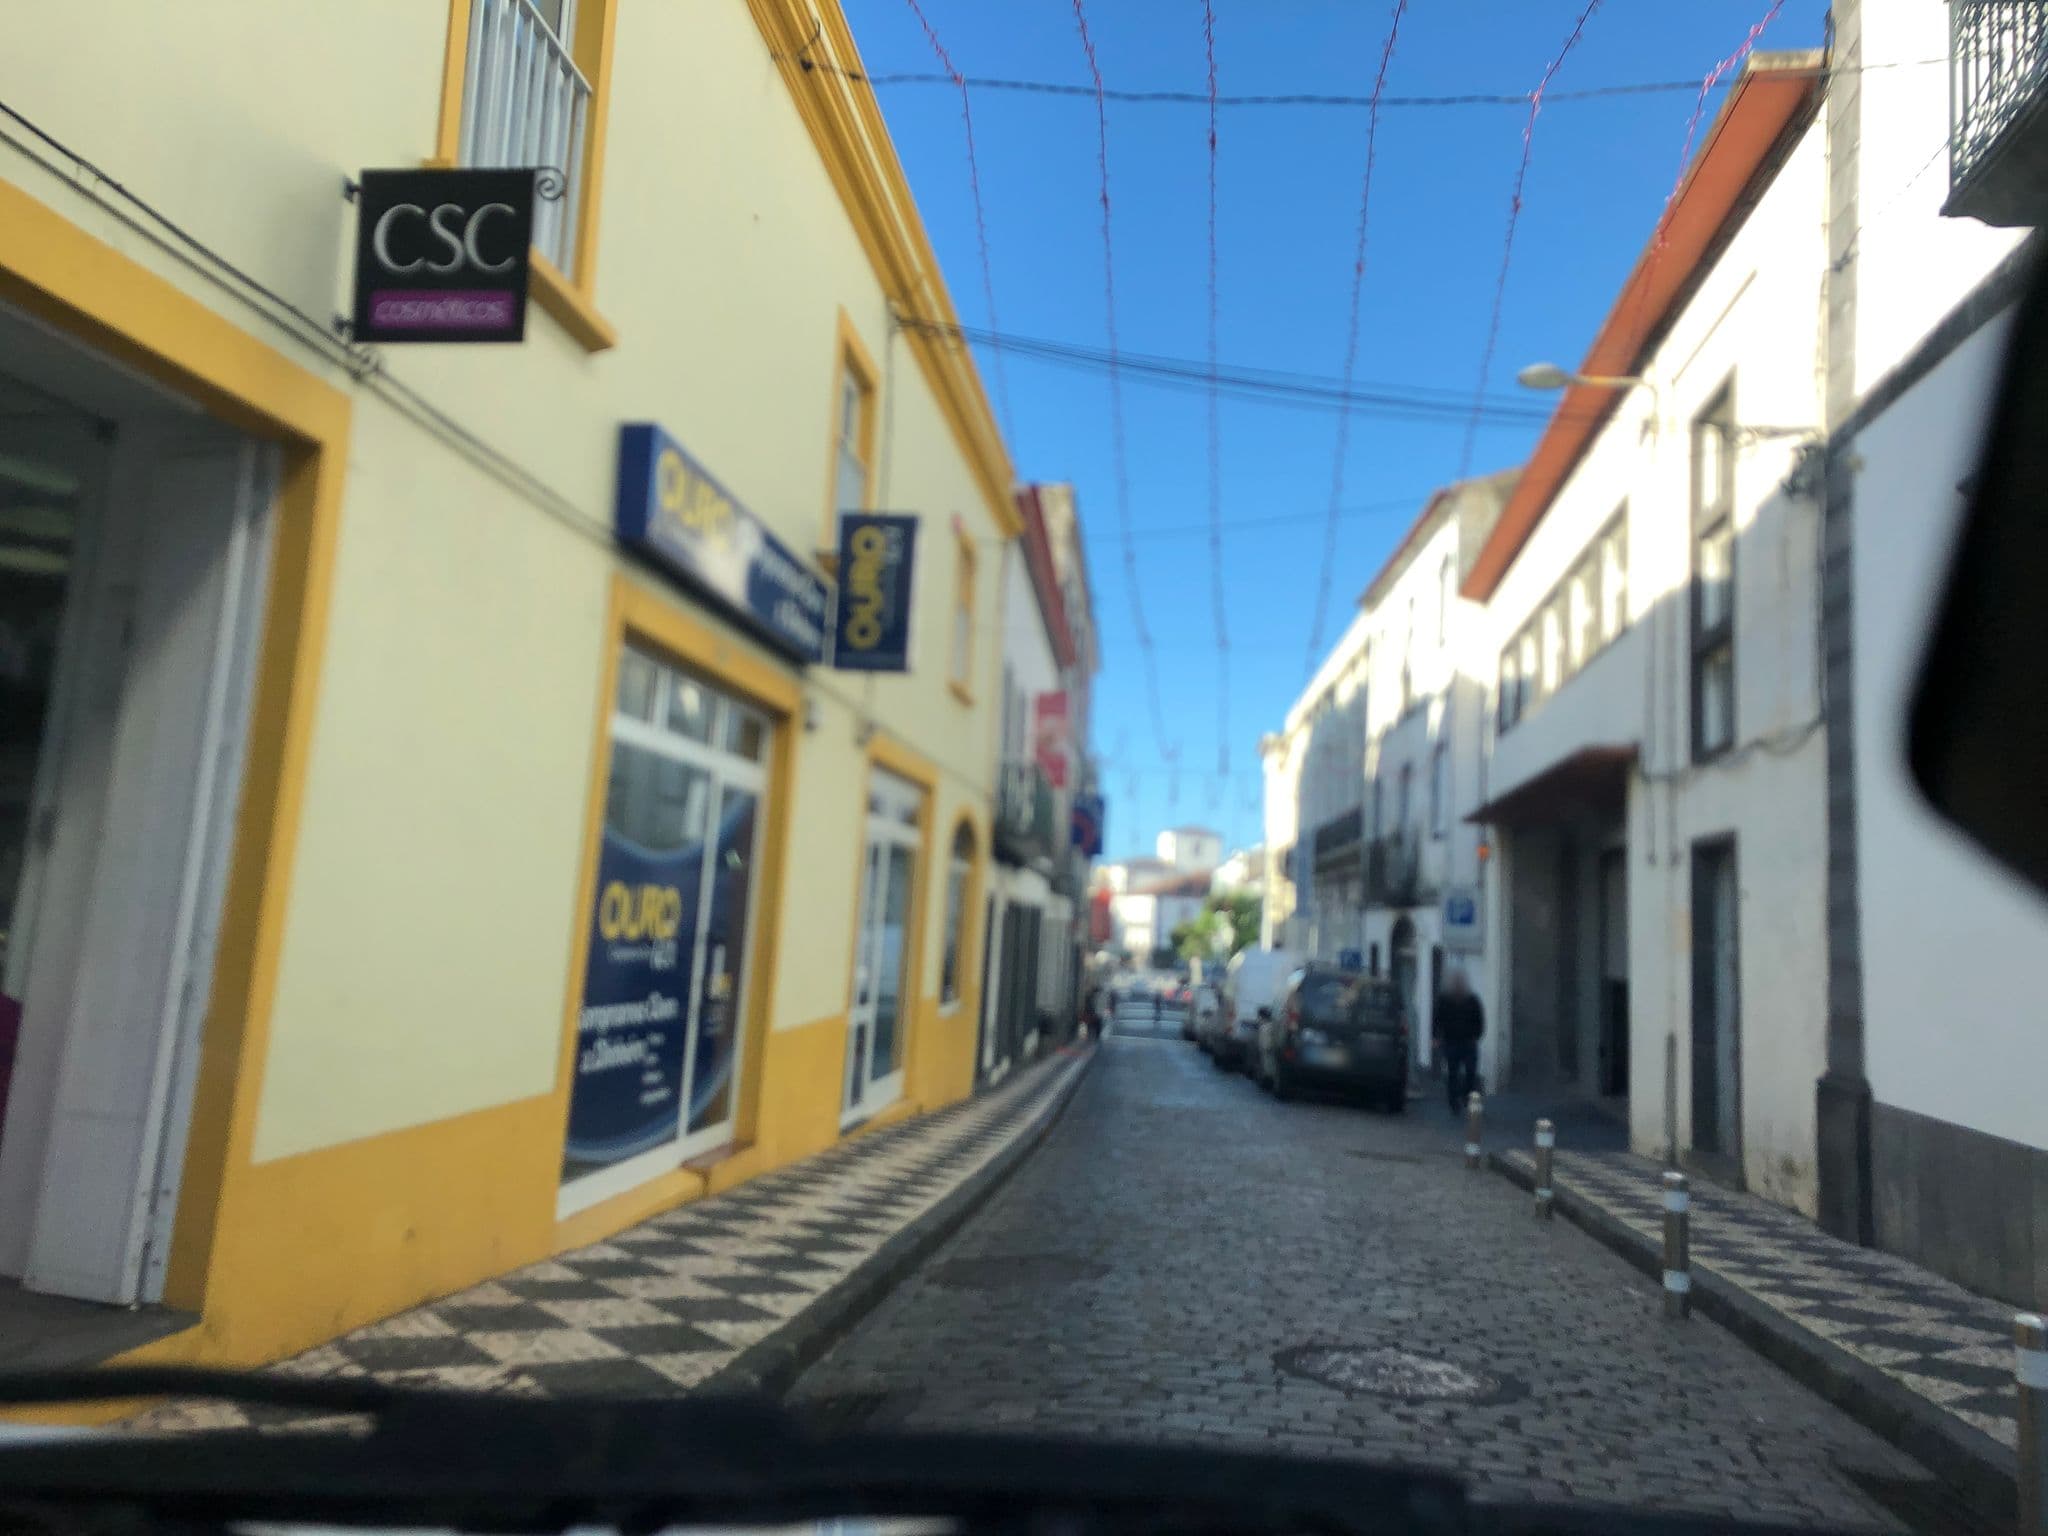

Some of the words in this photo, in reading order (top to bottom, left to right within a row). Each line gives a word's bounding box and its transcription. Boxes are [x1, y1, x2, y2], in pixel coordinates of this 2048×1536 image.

[373, 202, 515, 273] CSC
[846, 524, 886, 650] OURO
[600, 880, 681, 940] OURO
